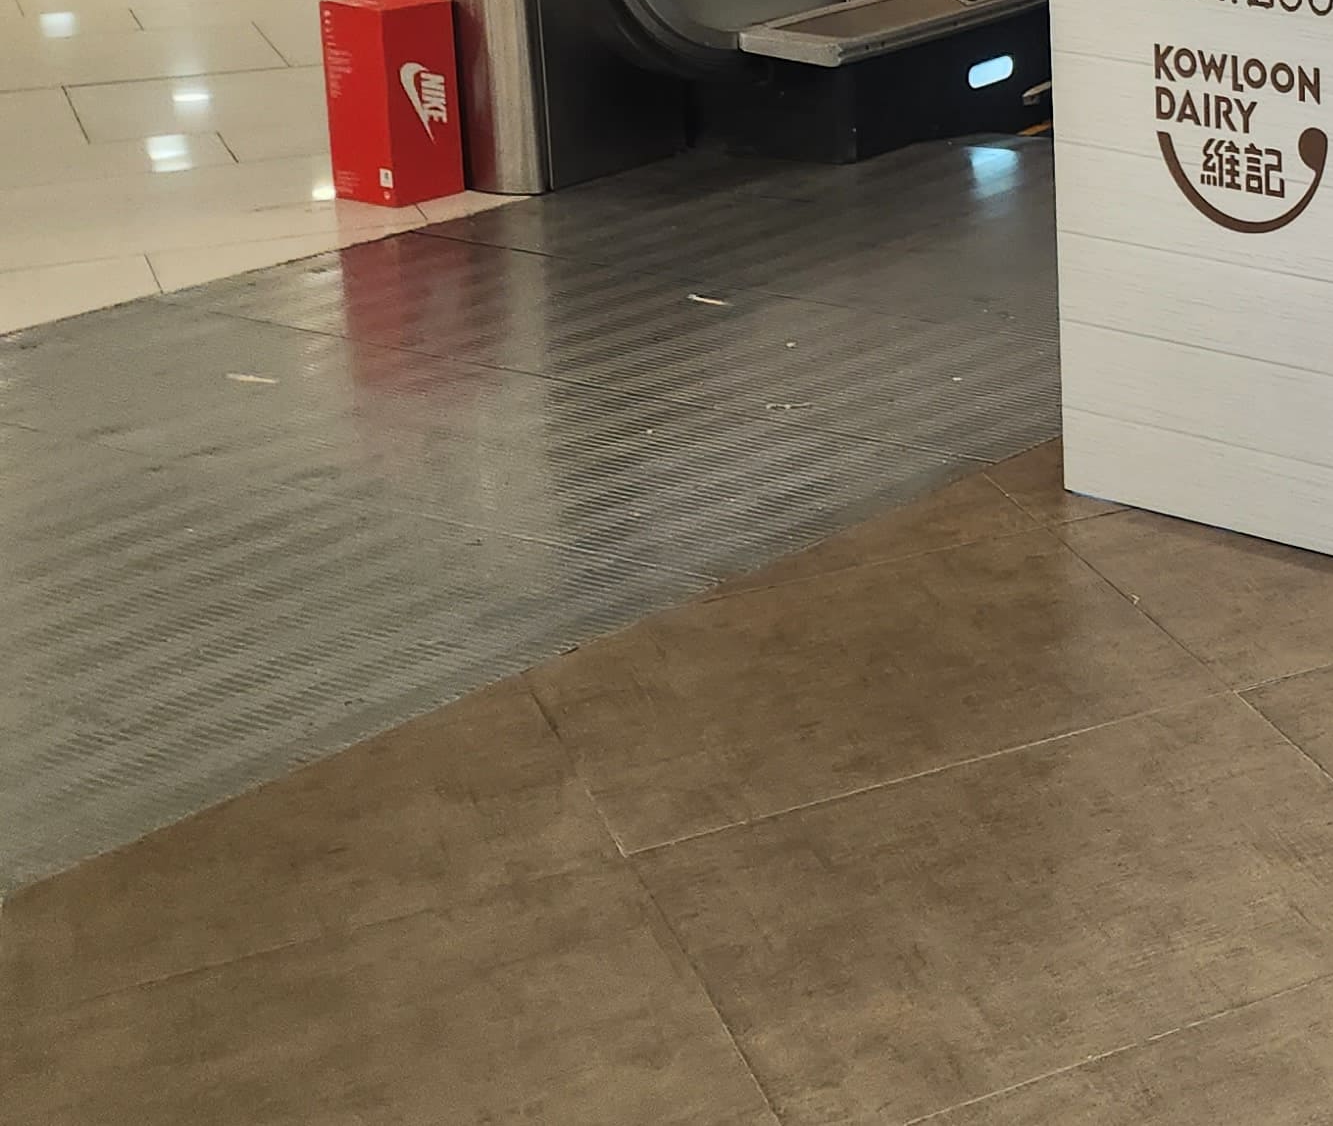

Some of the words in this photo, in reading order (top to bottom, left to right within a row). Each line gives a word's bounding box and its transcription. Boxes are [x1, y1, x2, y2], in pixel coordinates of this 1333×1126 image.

[420, 72, 448, 124] NIKE
[1153, 43, 1321, 105] KOWLOON
[1155, 85, 1257, 134] DAIRY
[1201, 138, 1285, 199] 維記
